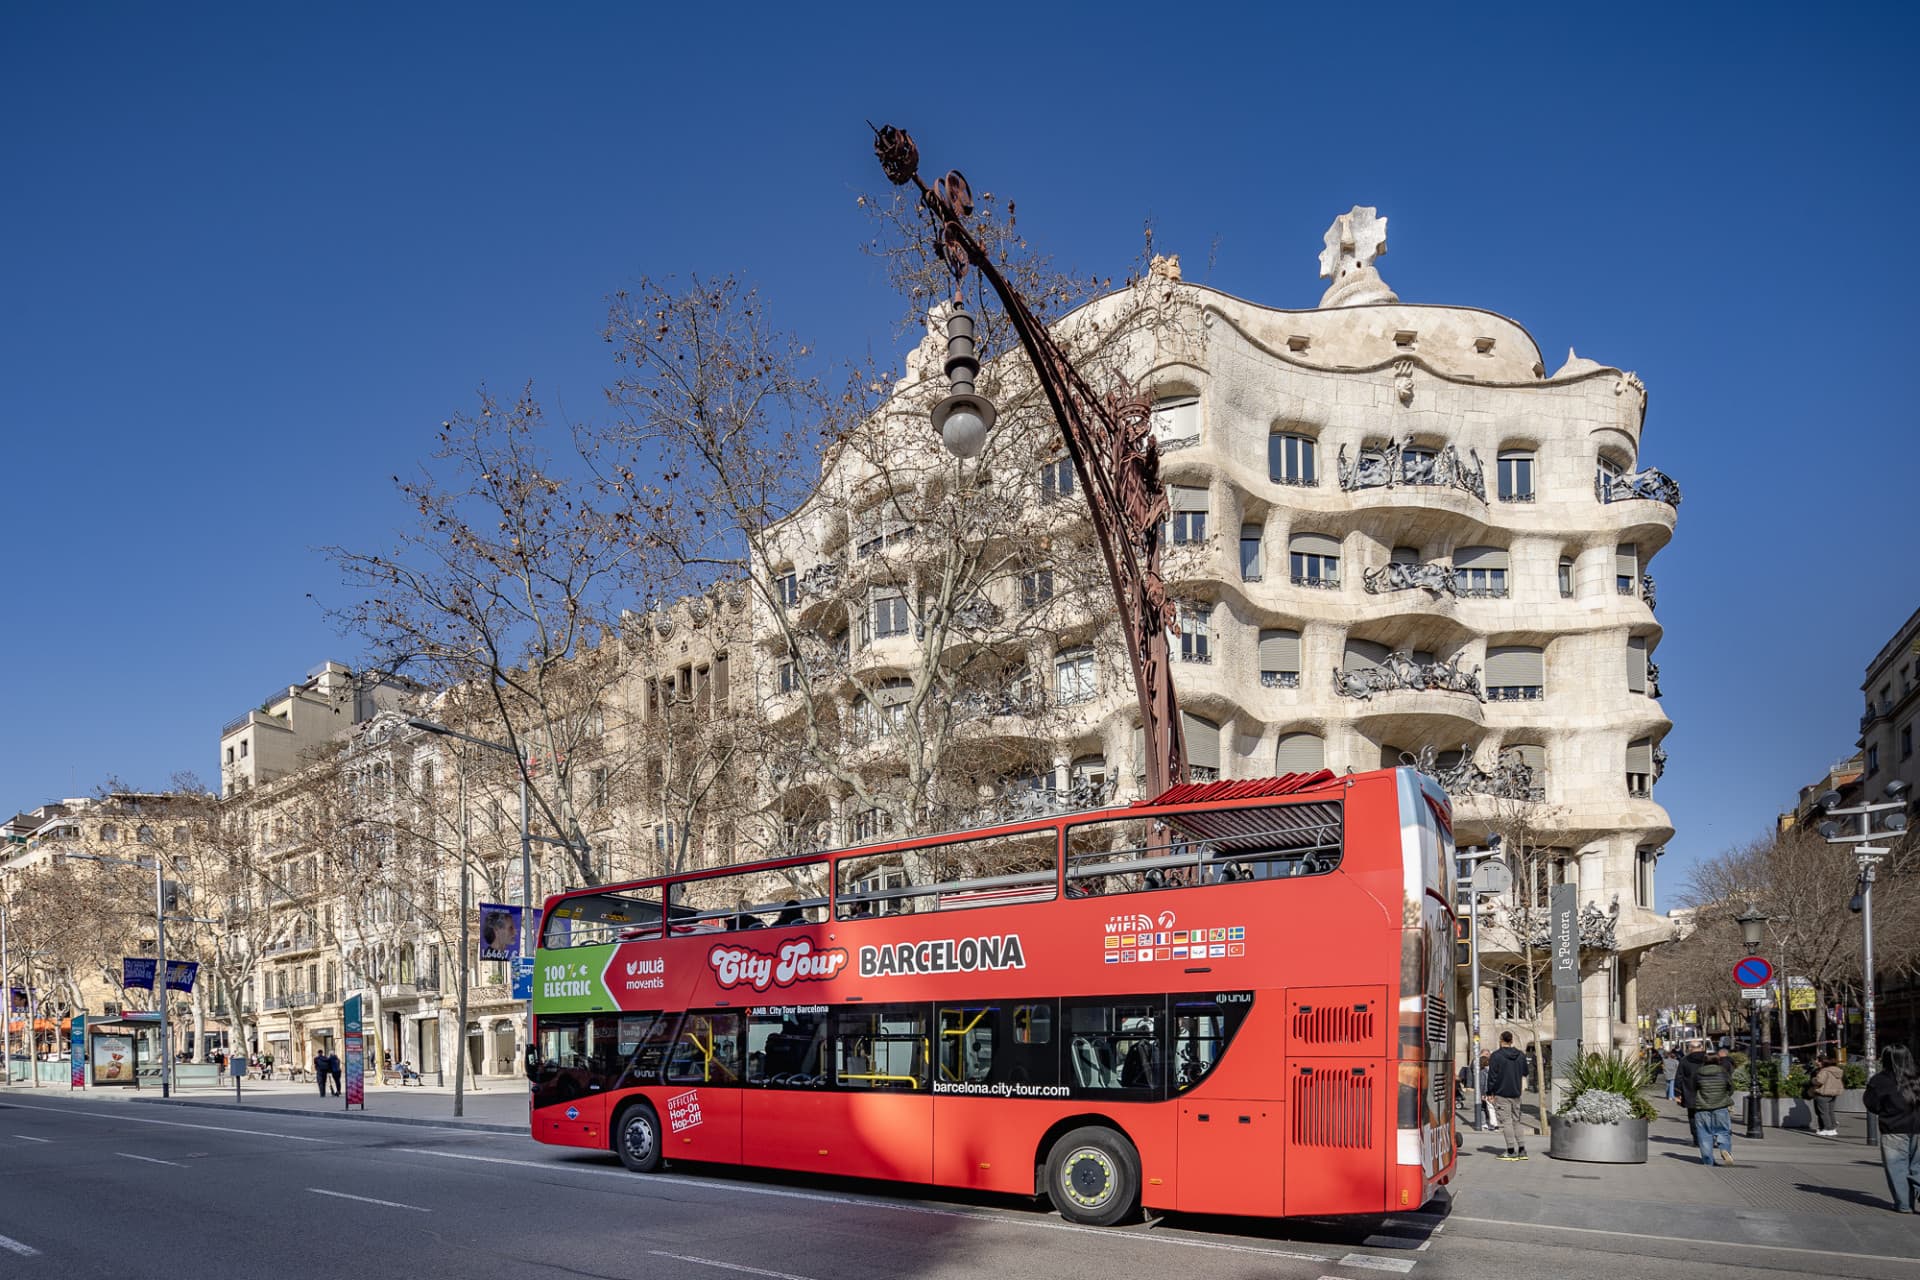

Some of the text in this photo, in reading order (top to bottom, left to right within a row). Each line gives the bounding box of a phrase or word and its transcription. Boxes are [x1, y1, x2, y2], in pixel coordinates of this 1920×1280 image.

[1110, 914, 1136, 922] FREE
[1558, 910, 1573, 971] La Pedrera
[711, 941, 844, 988] City Tour
[860, 935, 1025, 976] BARCELONA
[543, 980, 591, 998] ELECTRIC
[626, 977, 664, 989] moventis
[752, 1004, 829, 1015] AMB City Tour Barcelona
[933, 1080, 1070, 1097] barcelona.city-tour.com
[667, 1092, 698, 1110] OFFICIAL
[669, 1103, 700, 1121] Hop-On
[671, 1111, 702, 1130] Hop-Off
